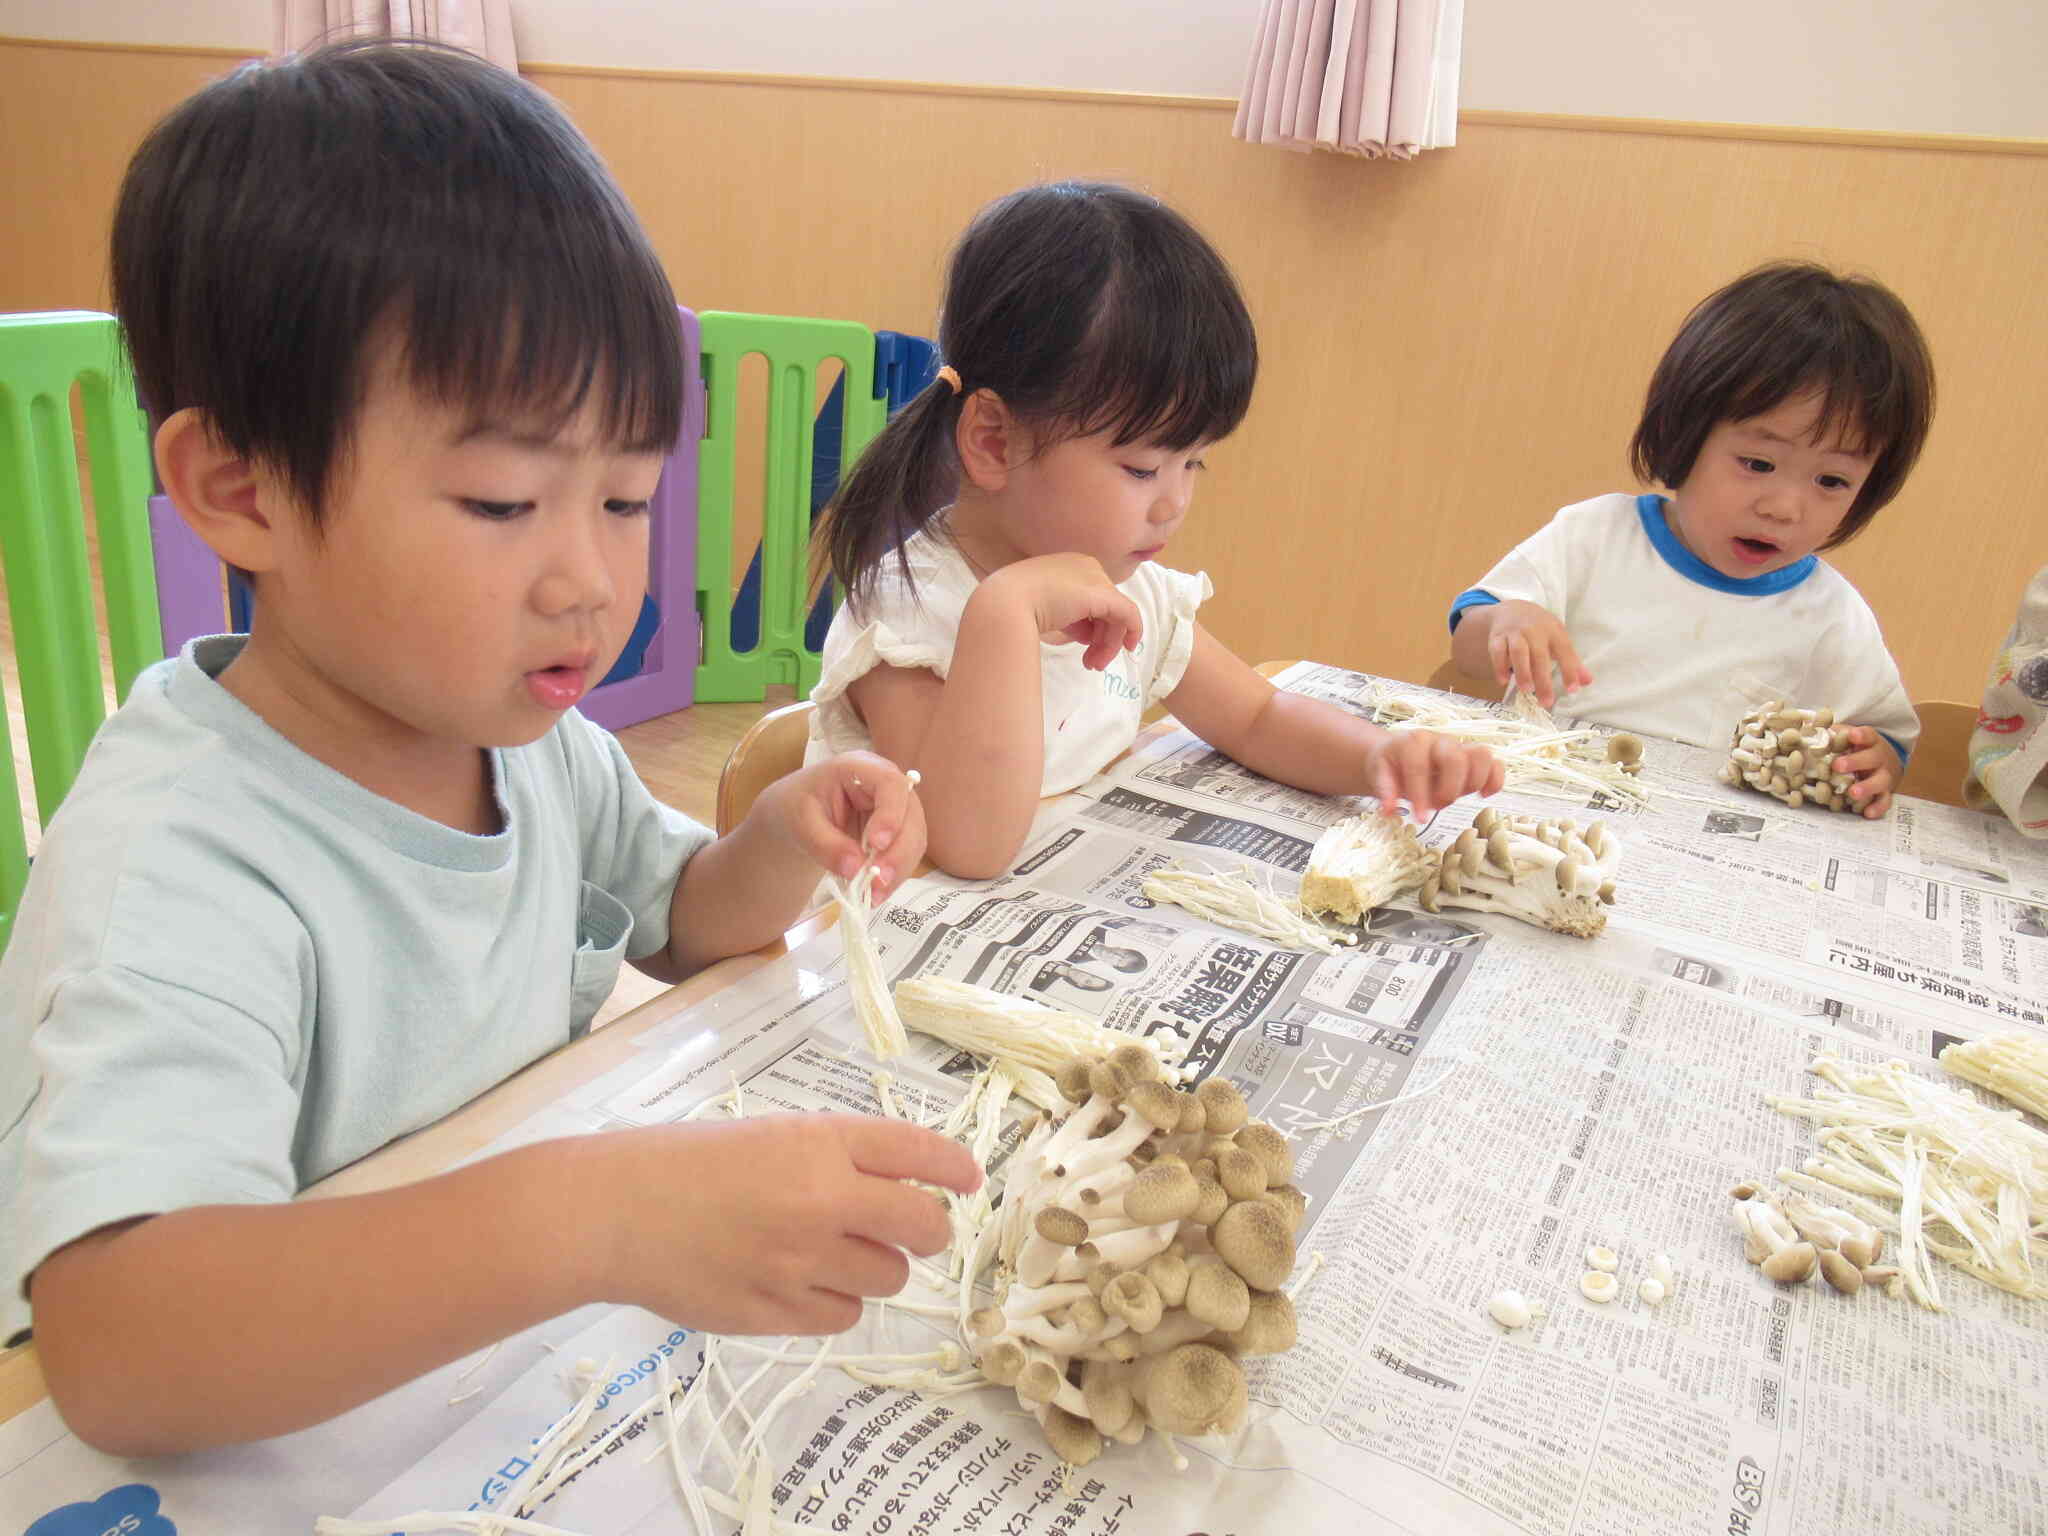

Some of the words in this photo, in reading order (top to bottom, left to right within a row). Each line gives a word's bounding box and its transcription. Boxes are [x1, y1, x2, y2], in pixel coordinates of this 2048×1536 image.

[866, 1421, 983, 1536] 保険を支えているの
[1089, 1494, 1135, 1536] イーデ
